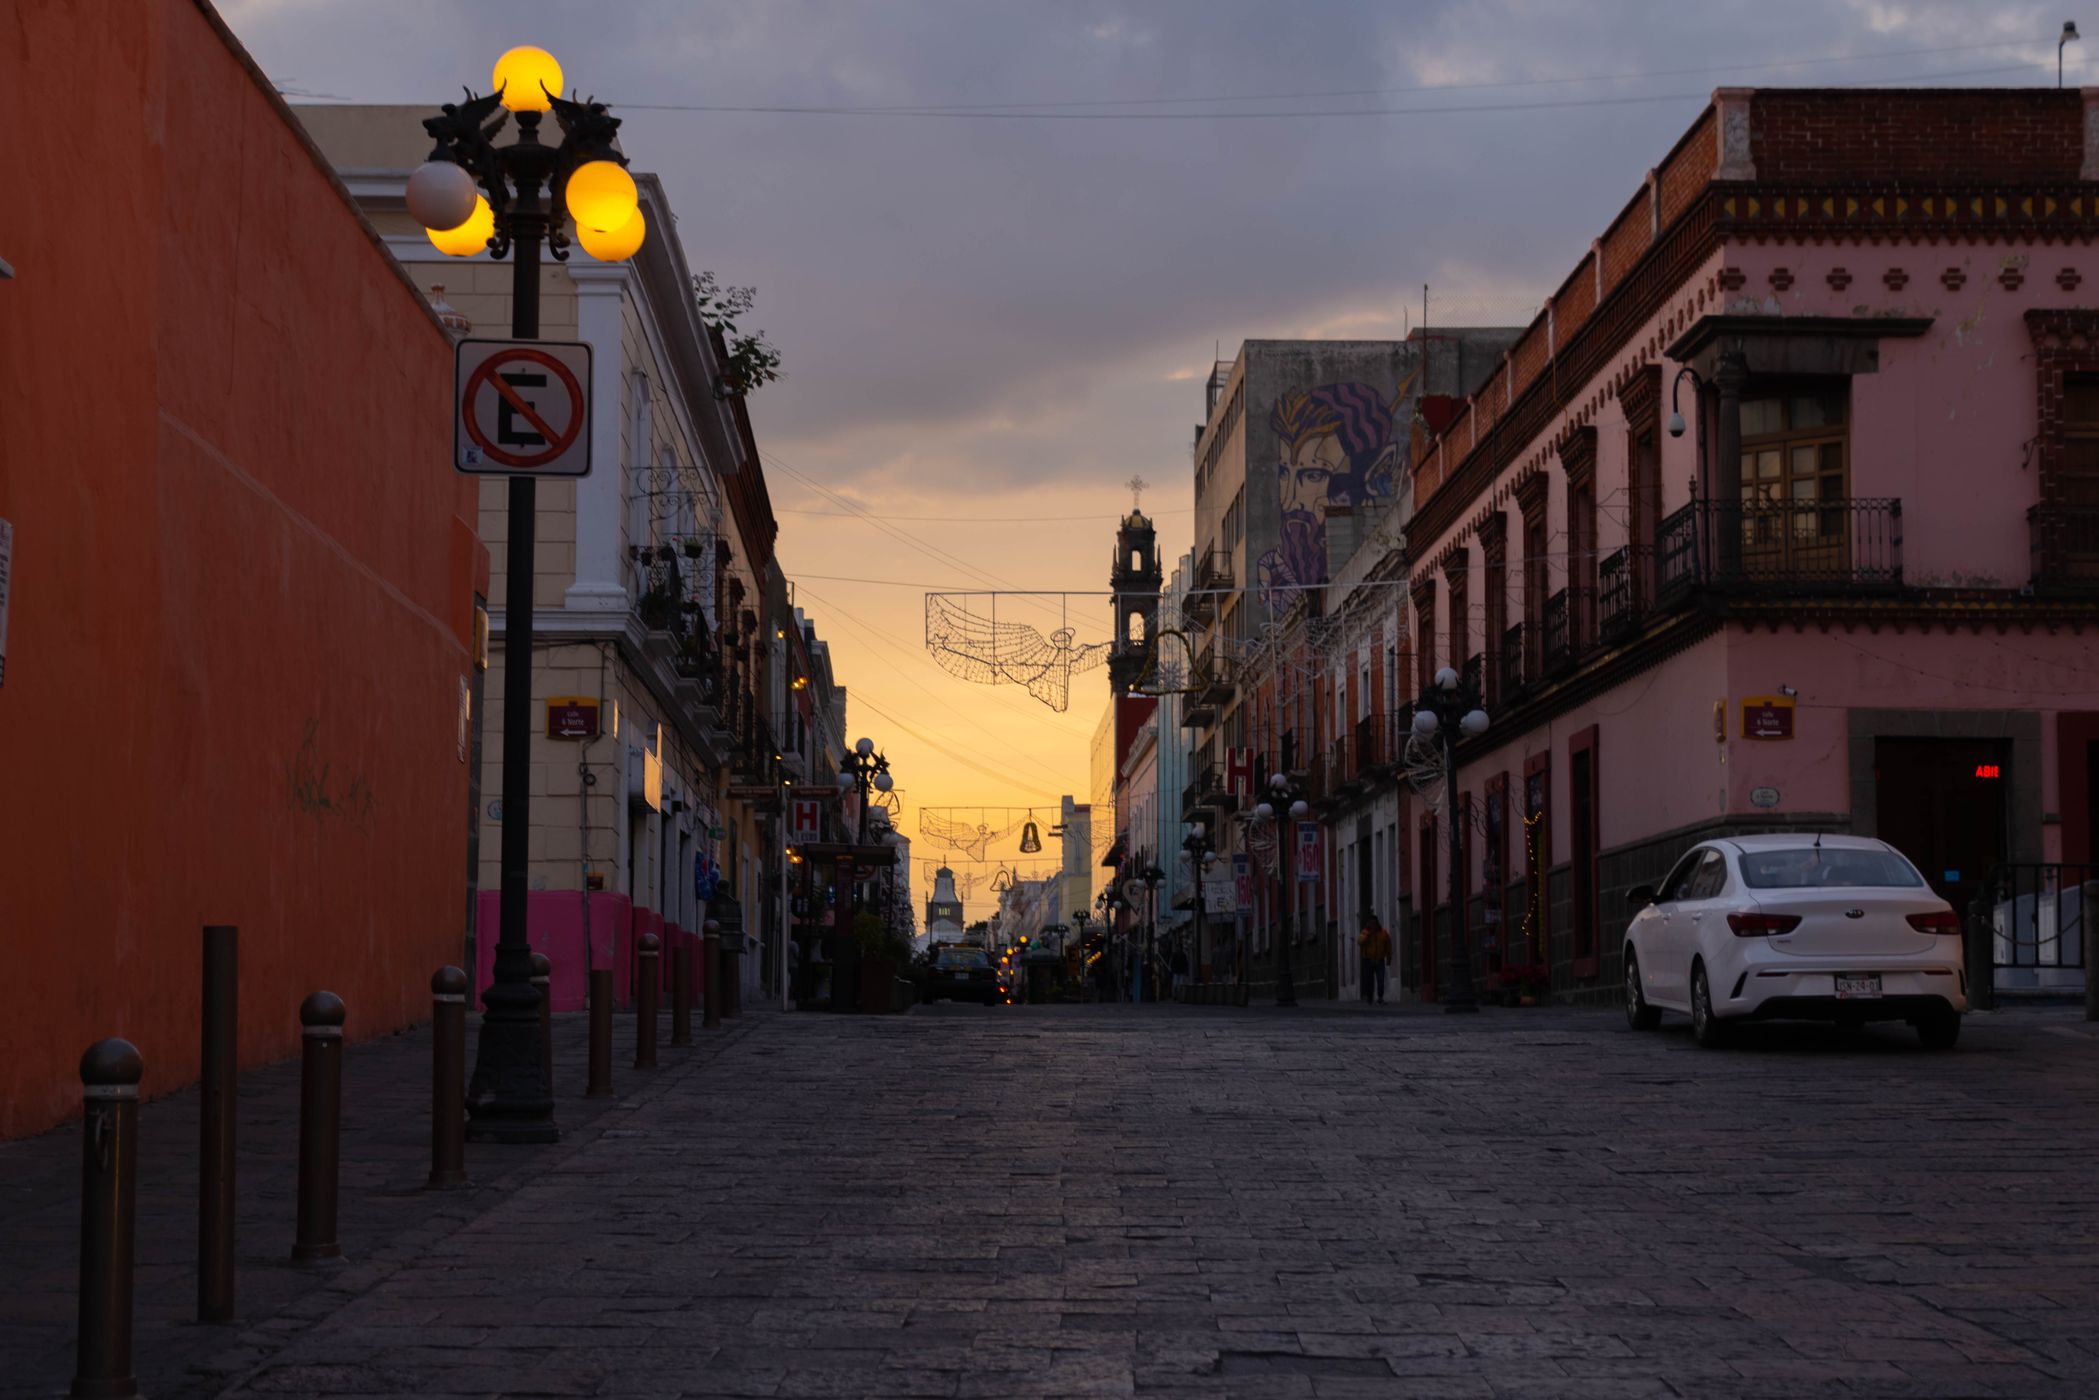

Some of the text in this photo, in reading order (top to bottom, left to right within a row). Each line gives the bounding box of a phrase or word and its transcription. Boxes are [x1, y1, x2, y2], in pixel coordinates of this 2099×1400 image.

[498, 374, 547, 445] E
[567, 718, 585, 726] Norte
[1762, 718, 1780, 726] Norte
[1227, 748, 1254, 795] H
[796, 803, 817, 831] H
